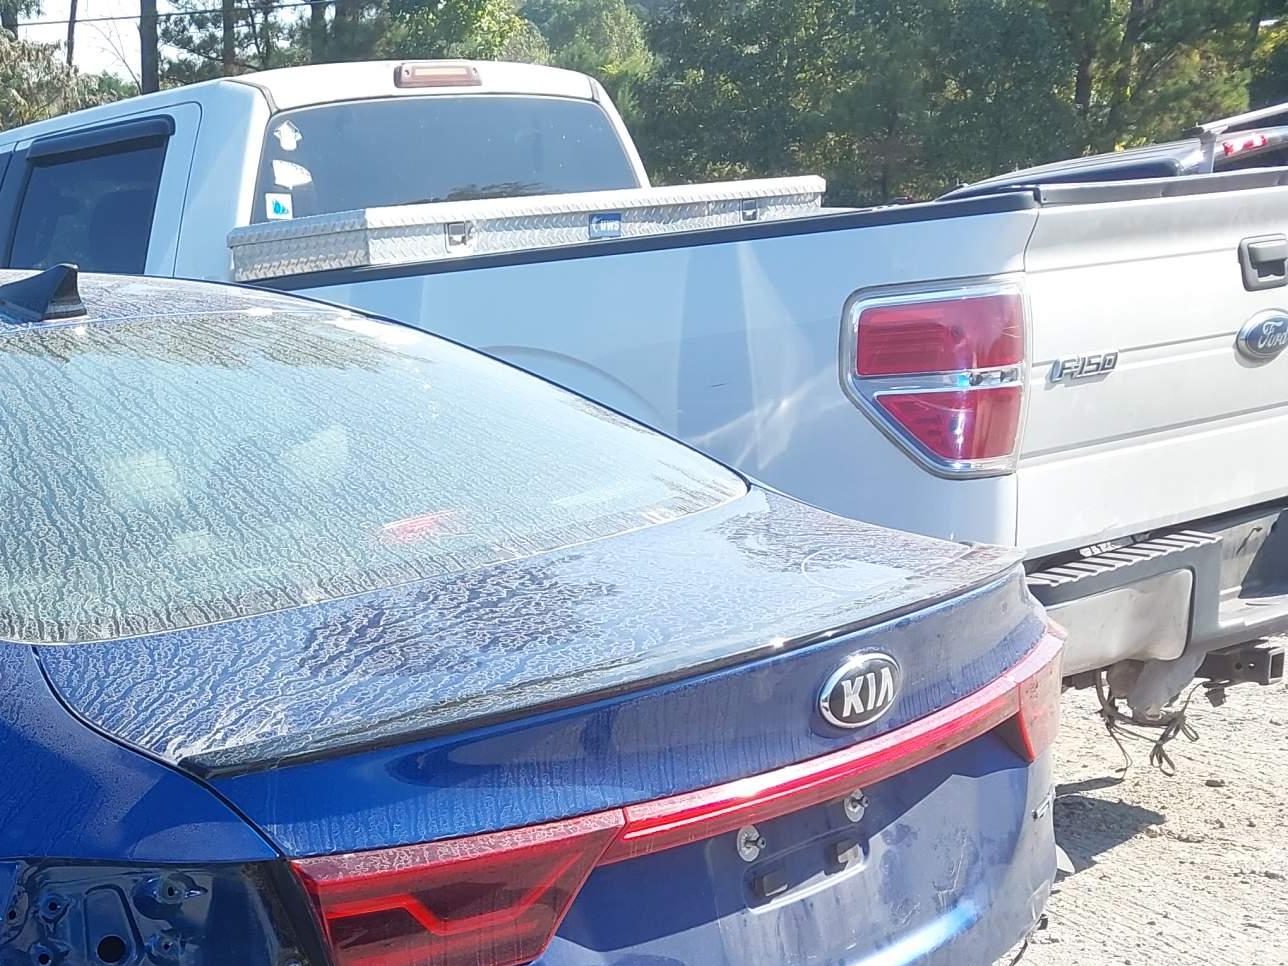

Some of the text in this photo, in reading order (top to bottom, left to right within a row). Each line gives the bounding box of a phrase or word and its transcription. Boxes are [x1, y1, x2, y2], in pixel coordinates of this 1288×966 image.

[1257, 320, 1288, 349] Ford
[1049, 351, 1119, 384] F-150
[840, 667, 894, 718] KIA
